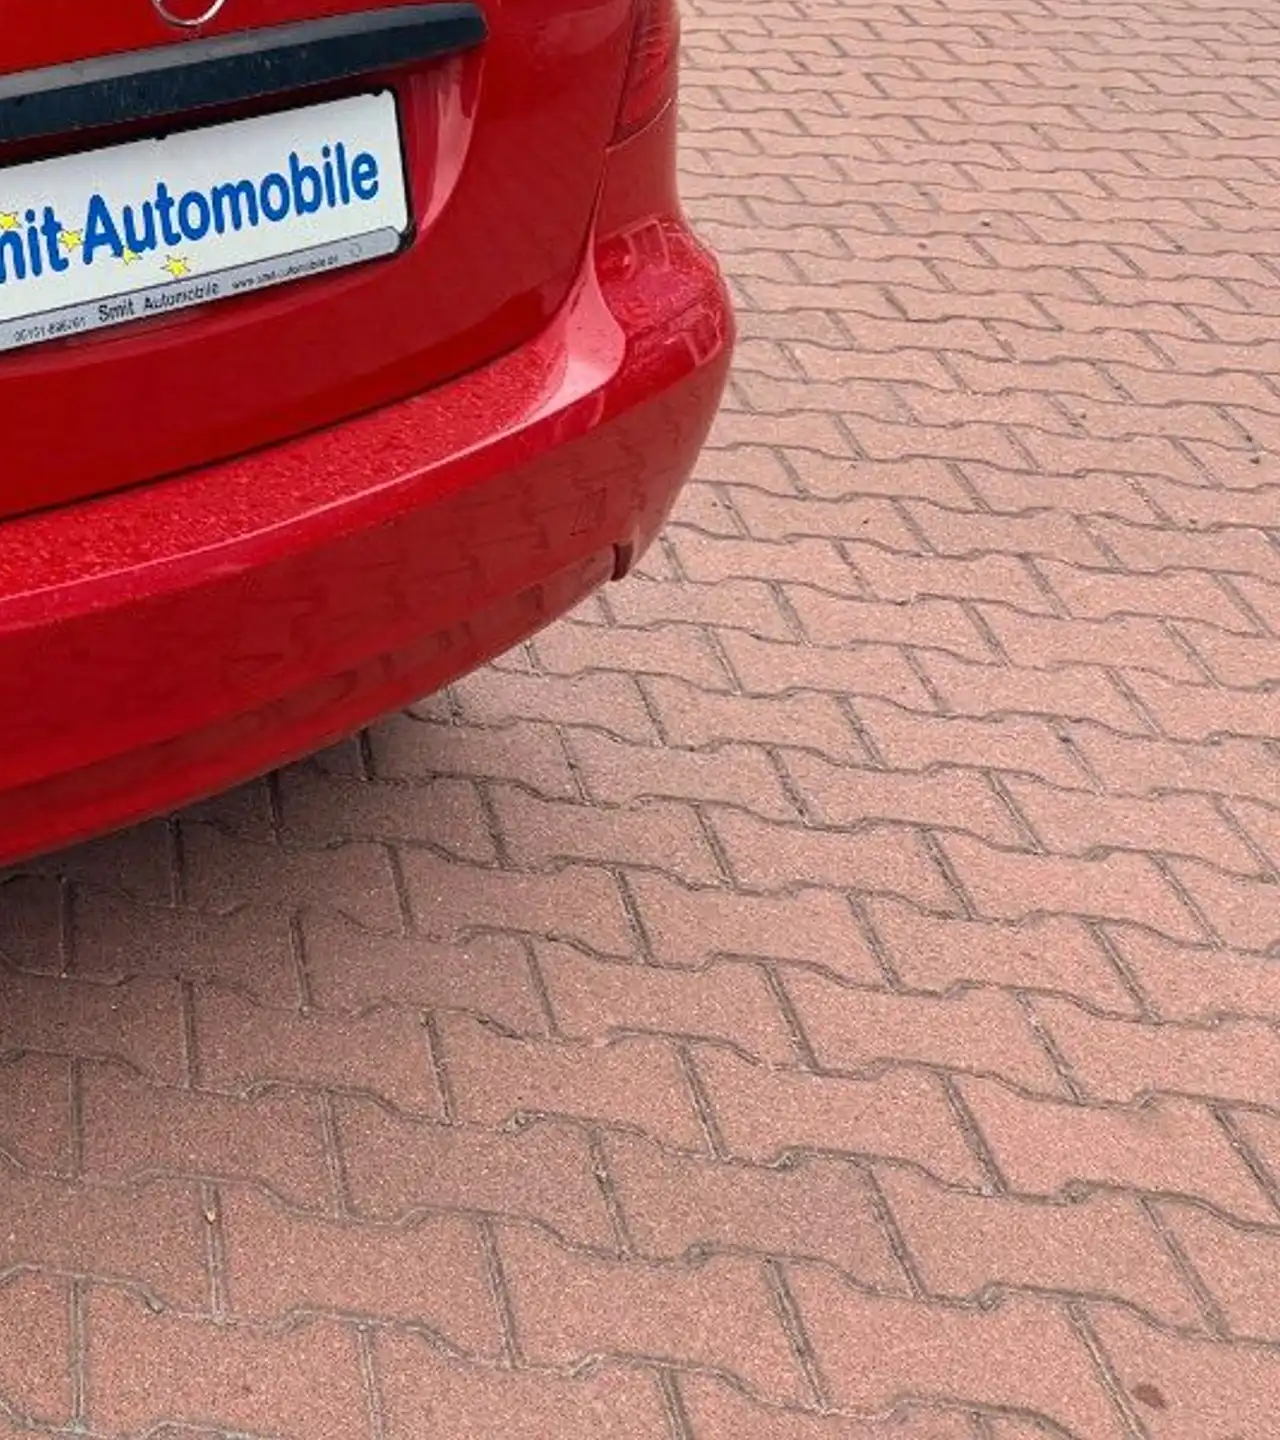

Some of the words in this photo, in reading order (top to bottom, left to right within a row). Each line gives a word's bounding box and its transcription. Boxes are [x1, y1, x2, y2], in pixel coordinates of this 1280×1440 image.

[82, 142, 380, 266] Automobile
[97, 297, 135, 323] Smit
[143, 280, 219, 310] Automobile
